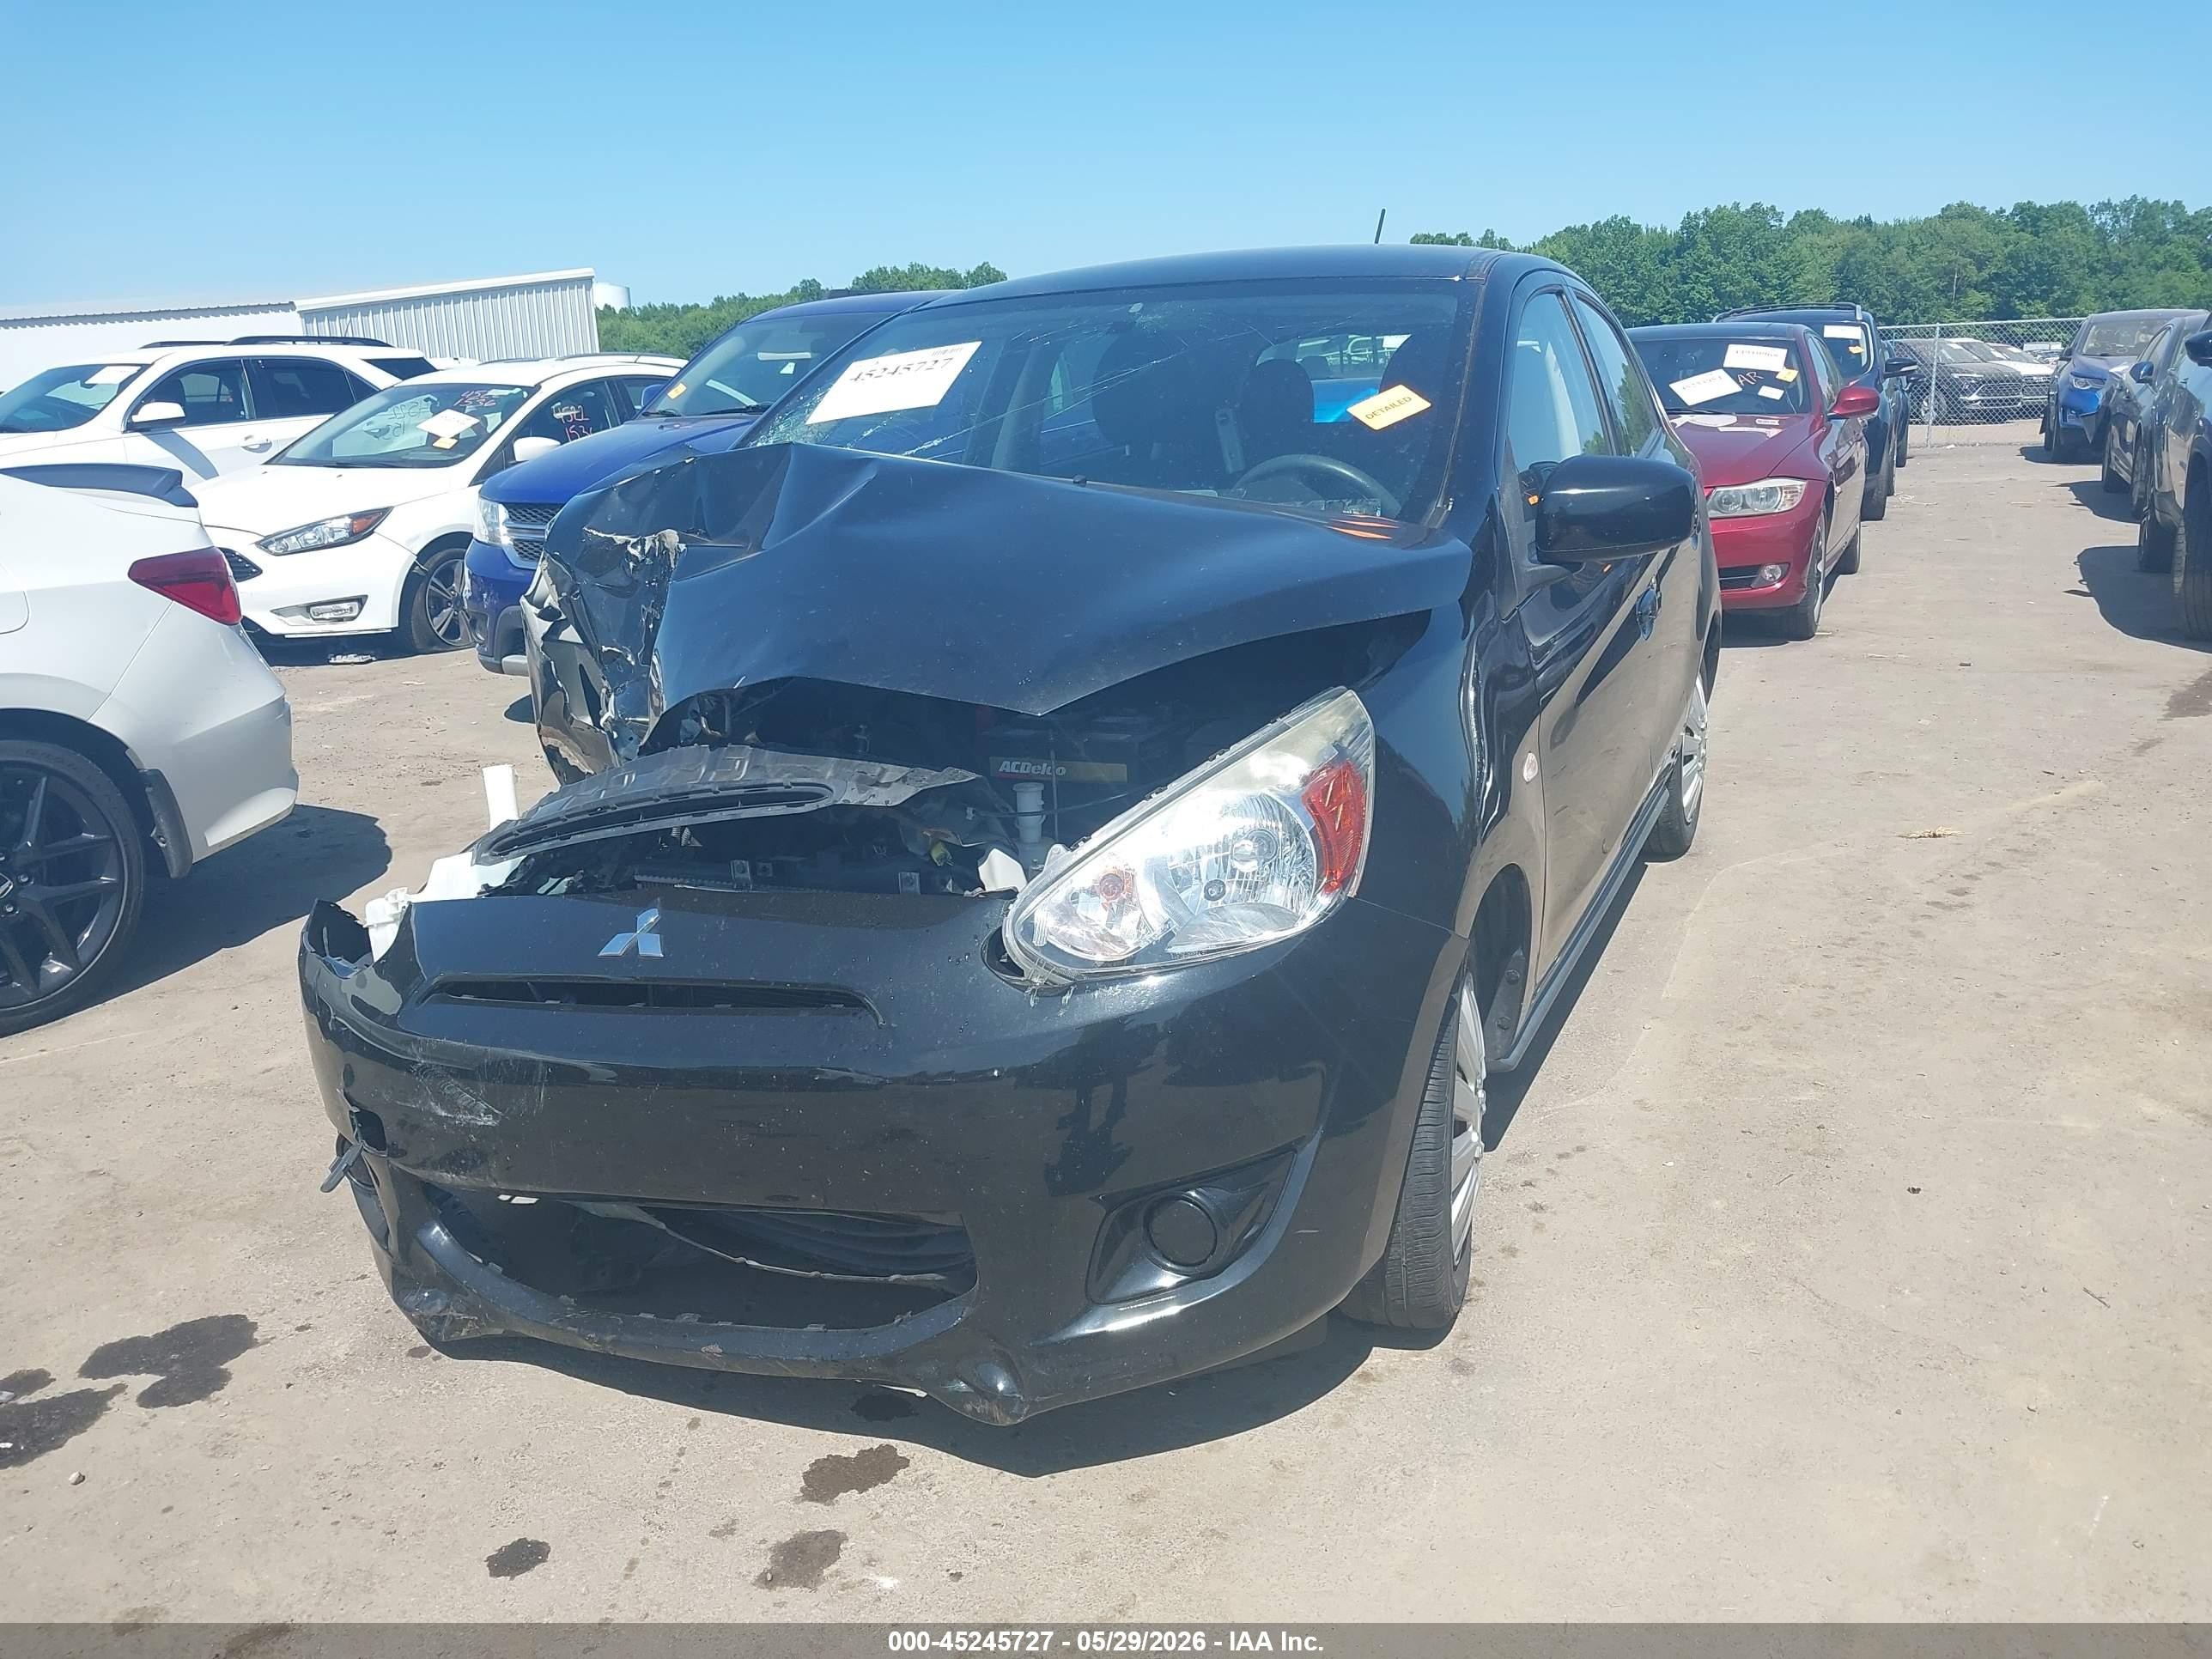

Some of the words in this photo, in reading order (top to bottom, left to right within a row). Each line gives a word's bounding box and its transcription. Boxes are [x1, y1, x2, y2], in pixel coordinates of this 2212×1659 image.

[849, 356, 954, 381] 45245727
[1365, 396, 1412, 420] DETAILED
[998, 760, 1066, 776] ACDelco
